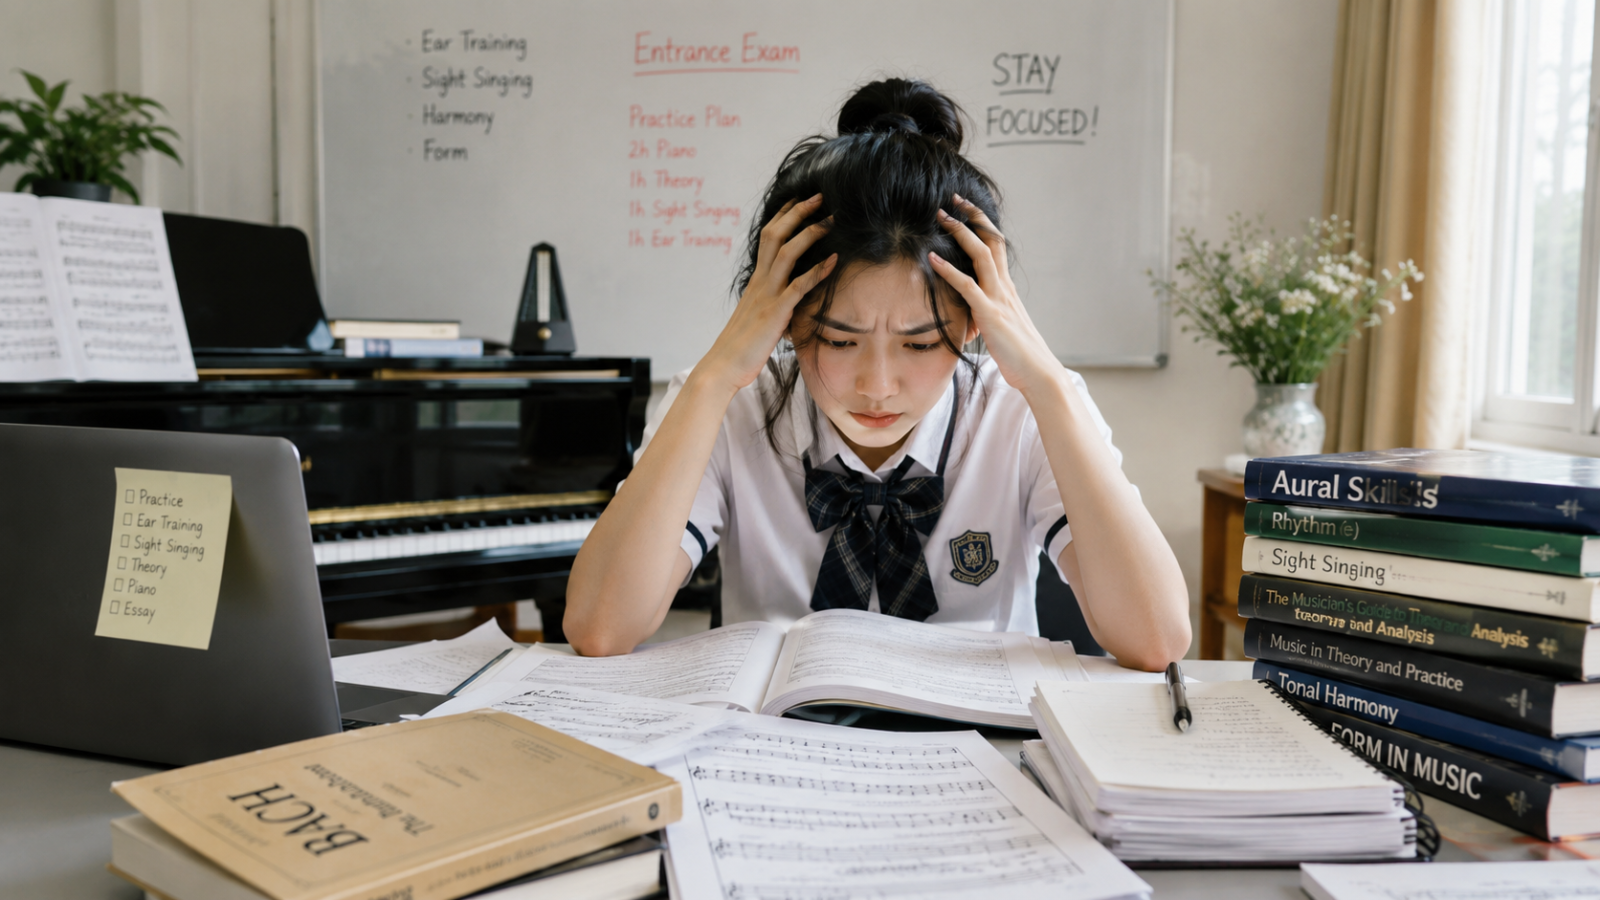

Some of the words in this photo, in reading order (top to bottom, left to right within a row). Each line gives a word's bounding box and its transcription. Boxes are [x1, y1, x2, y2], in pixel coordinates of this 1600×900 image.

[422, 28, 453, 53] Ear
[459, 28, 527, 62] Training
[634, 31, 731, 65] Entrance
[741, 31, 800, 64] Exam
[422, 66, 466, 98] Sight
[473, 66, 533, 99] Singing
[992, 52, 1061, 94] STAY
[423, 102, 495, 135] Harmony
[629, 104, 697, 129] Practice
[705, 104, 742, 128] Plan
[986, 105, 1099, 137] FOCUSED!
[423, 138, 469, 162] Form
[628, 138, 650, 159] 2h
[656, 138, 698, 159] Piano
[630, 169, 648, 189] 1h
[654, 169, 705, 196] Theory
[629, 199, 646, 218] 1h
[652, 199, 688, 226] Sight
[693, 199, 742, 227] Singing
[628, 228, 645, 248] 1h
[651, 228, 675, 249] Ear
[682, 228, 733, 255] Training
[138, 488, 184, 508] Practice
[1271, 469, 1340, 501] Aural
[137, 512, 157, 528] Ear
[160, 515, 204, 539] Training
[1271, 511, 1336, 537] Rhythm
[133, 534, 162, 556] Sight
[166, 538, 205, 562] Singing
[131, 557, 168, 579] Theory
[1271, 547, 1317, 574] Sight
[1322, 554, 1386, 586] Singing
[127, 578, 157, 596] Piano
[123, 600, 156, 625] Essay
[1266, 589, 1289, 605] The
[1291, 592, 1354, 614] Musician's
[1471, 622, 1530, 649] Analysis
[1376, 621, 1435, 646] Analysis
[1270, 633, 1308, 655] Music
[1310, 641, 1323, 659] in
[1326, 646, 1374, 674] Theory
[1375, 660, 1401, 678] and
[1405, 664, 1464, 693] Practice
[1278, 671, 1320, 701] Tonal
[1325, 683, 1400, 726] Harmony
[1386, 743, 1410, 773] IN
[1412, 752, 1484, 801] MUSIC
[227, 781, 370, 858] BACH
